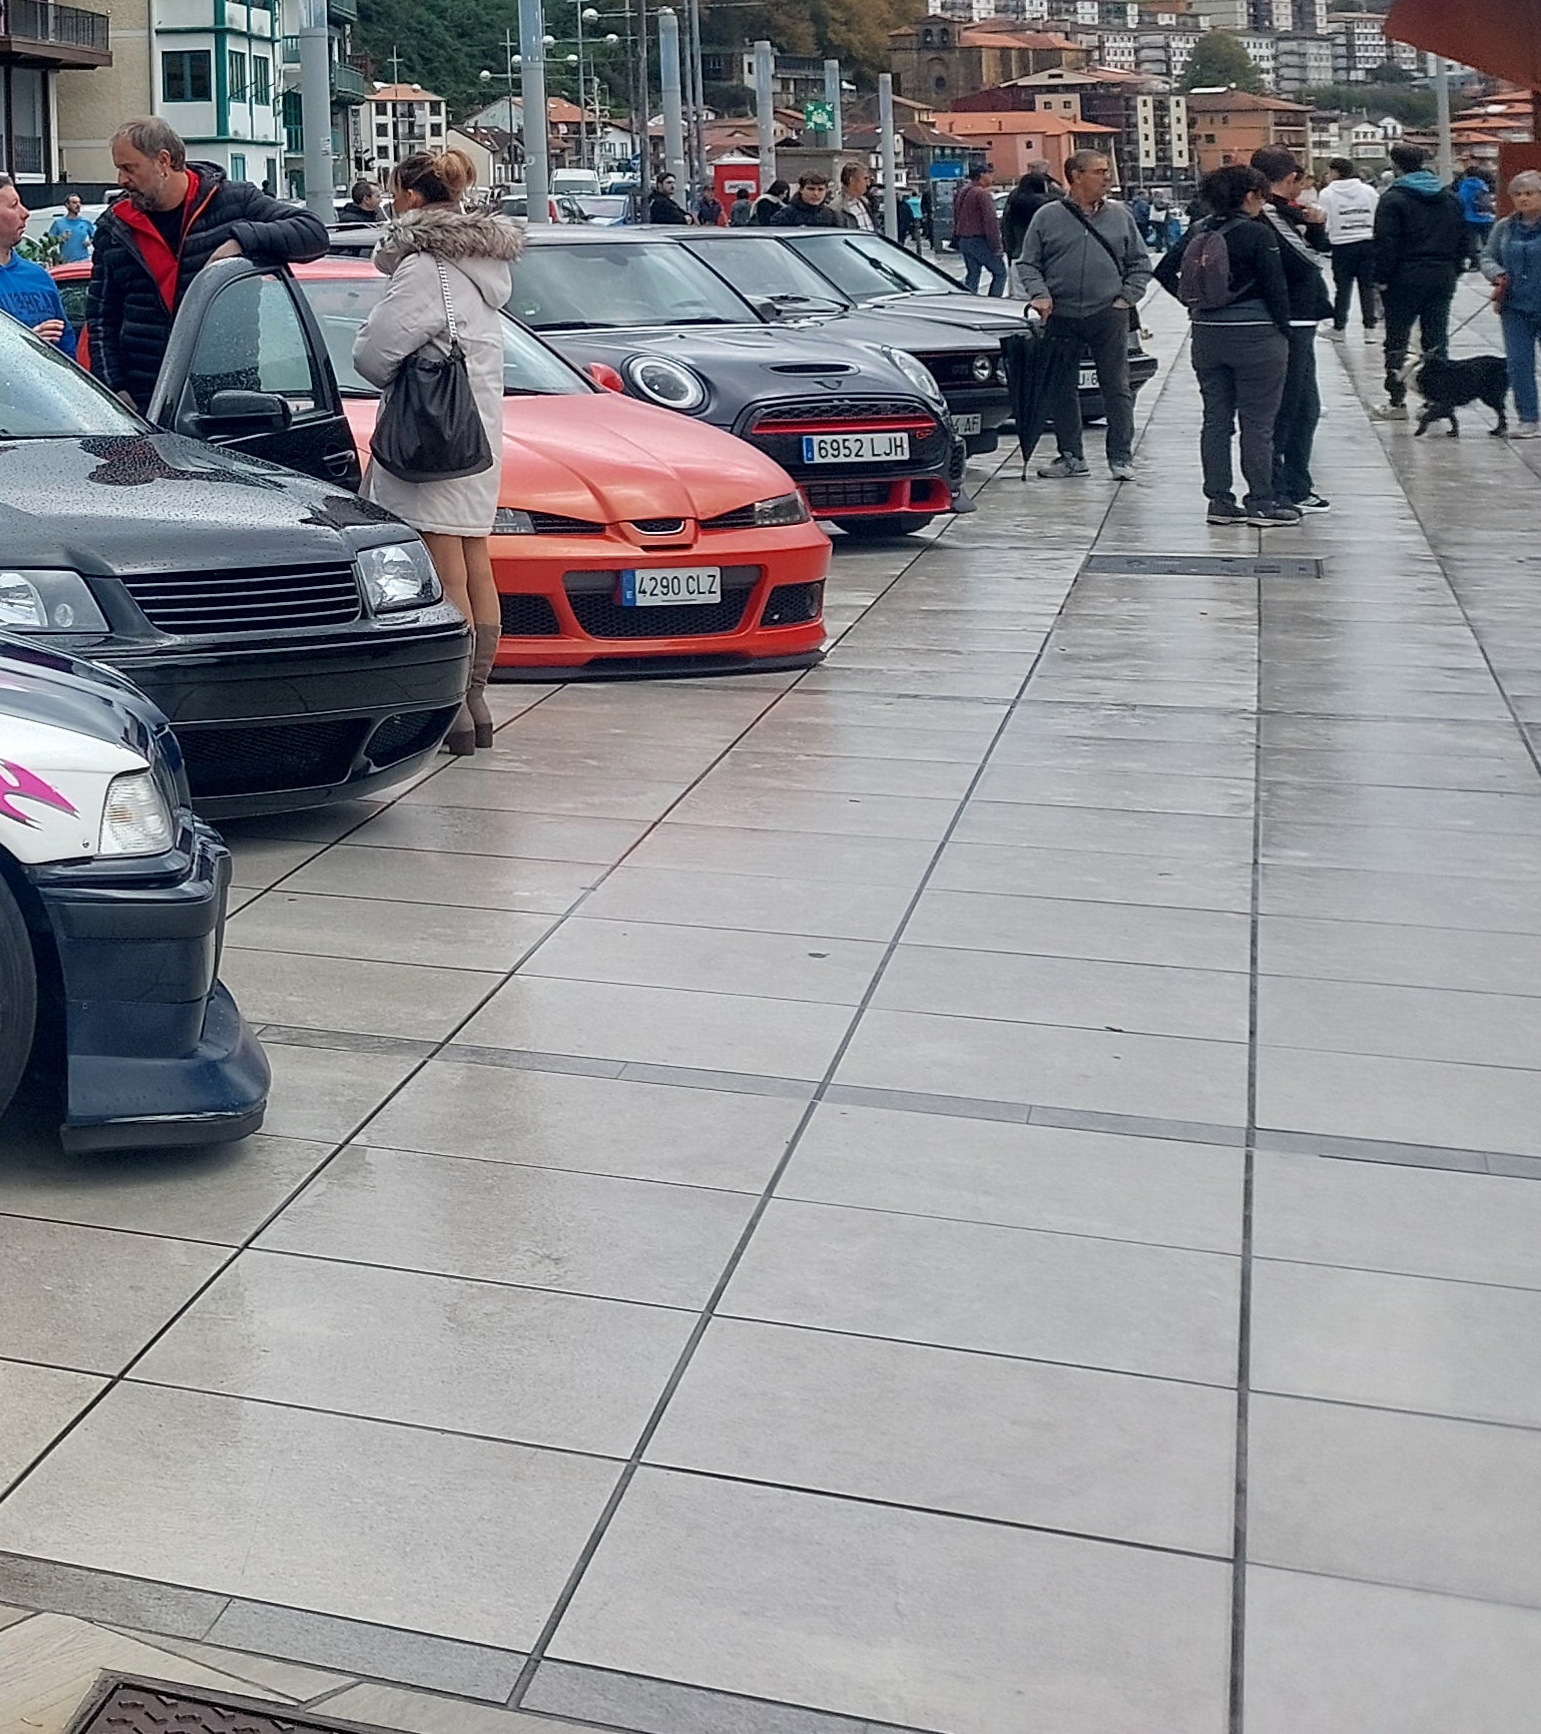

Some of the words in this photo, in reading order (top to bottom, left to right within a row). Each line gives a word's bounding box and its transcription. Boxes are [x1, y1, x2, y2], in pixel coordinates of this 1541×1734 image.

[818, 439, 864, 459] 6952
[870, 436, 904, 458] LJH
[637, 574, 681, 597] 4290
[686, 572, 718, 596] CLZ
